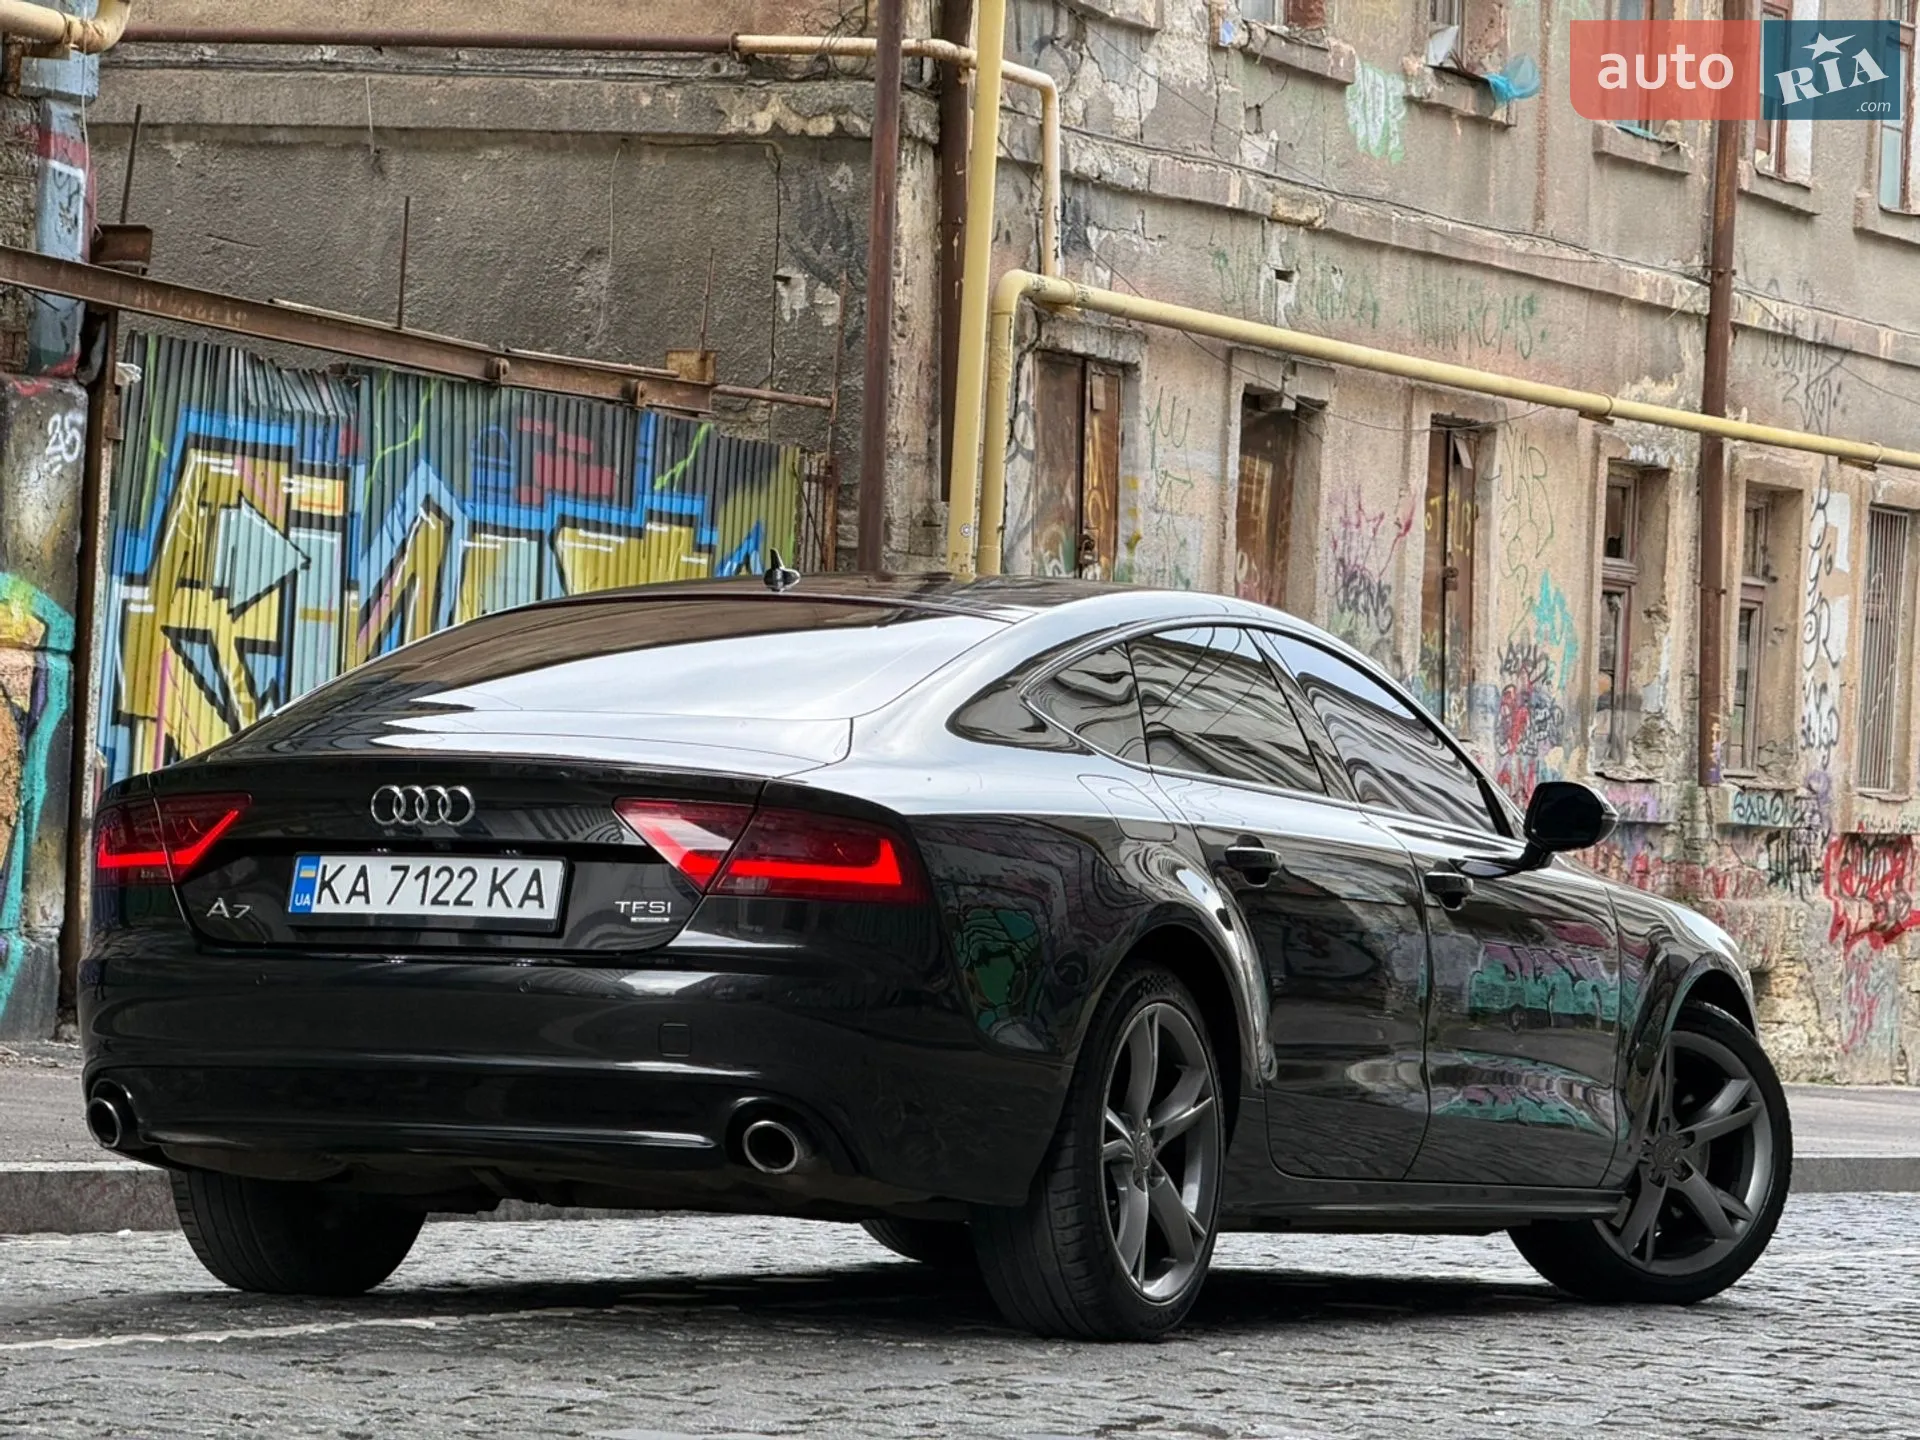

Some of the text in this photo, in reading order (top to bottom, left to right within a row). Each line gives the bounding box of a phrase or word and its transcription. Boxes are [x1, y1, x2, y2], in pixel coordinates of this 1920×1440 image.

[316, 864, 545, 909] KA 7122 KA
[206, 897, 251, 919] A7
[294, 893, 311, 906] UA
[614, 901, 672, 914] TFSI
